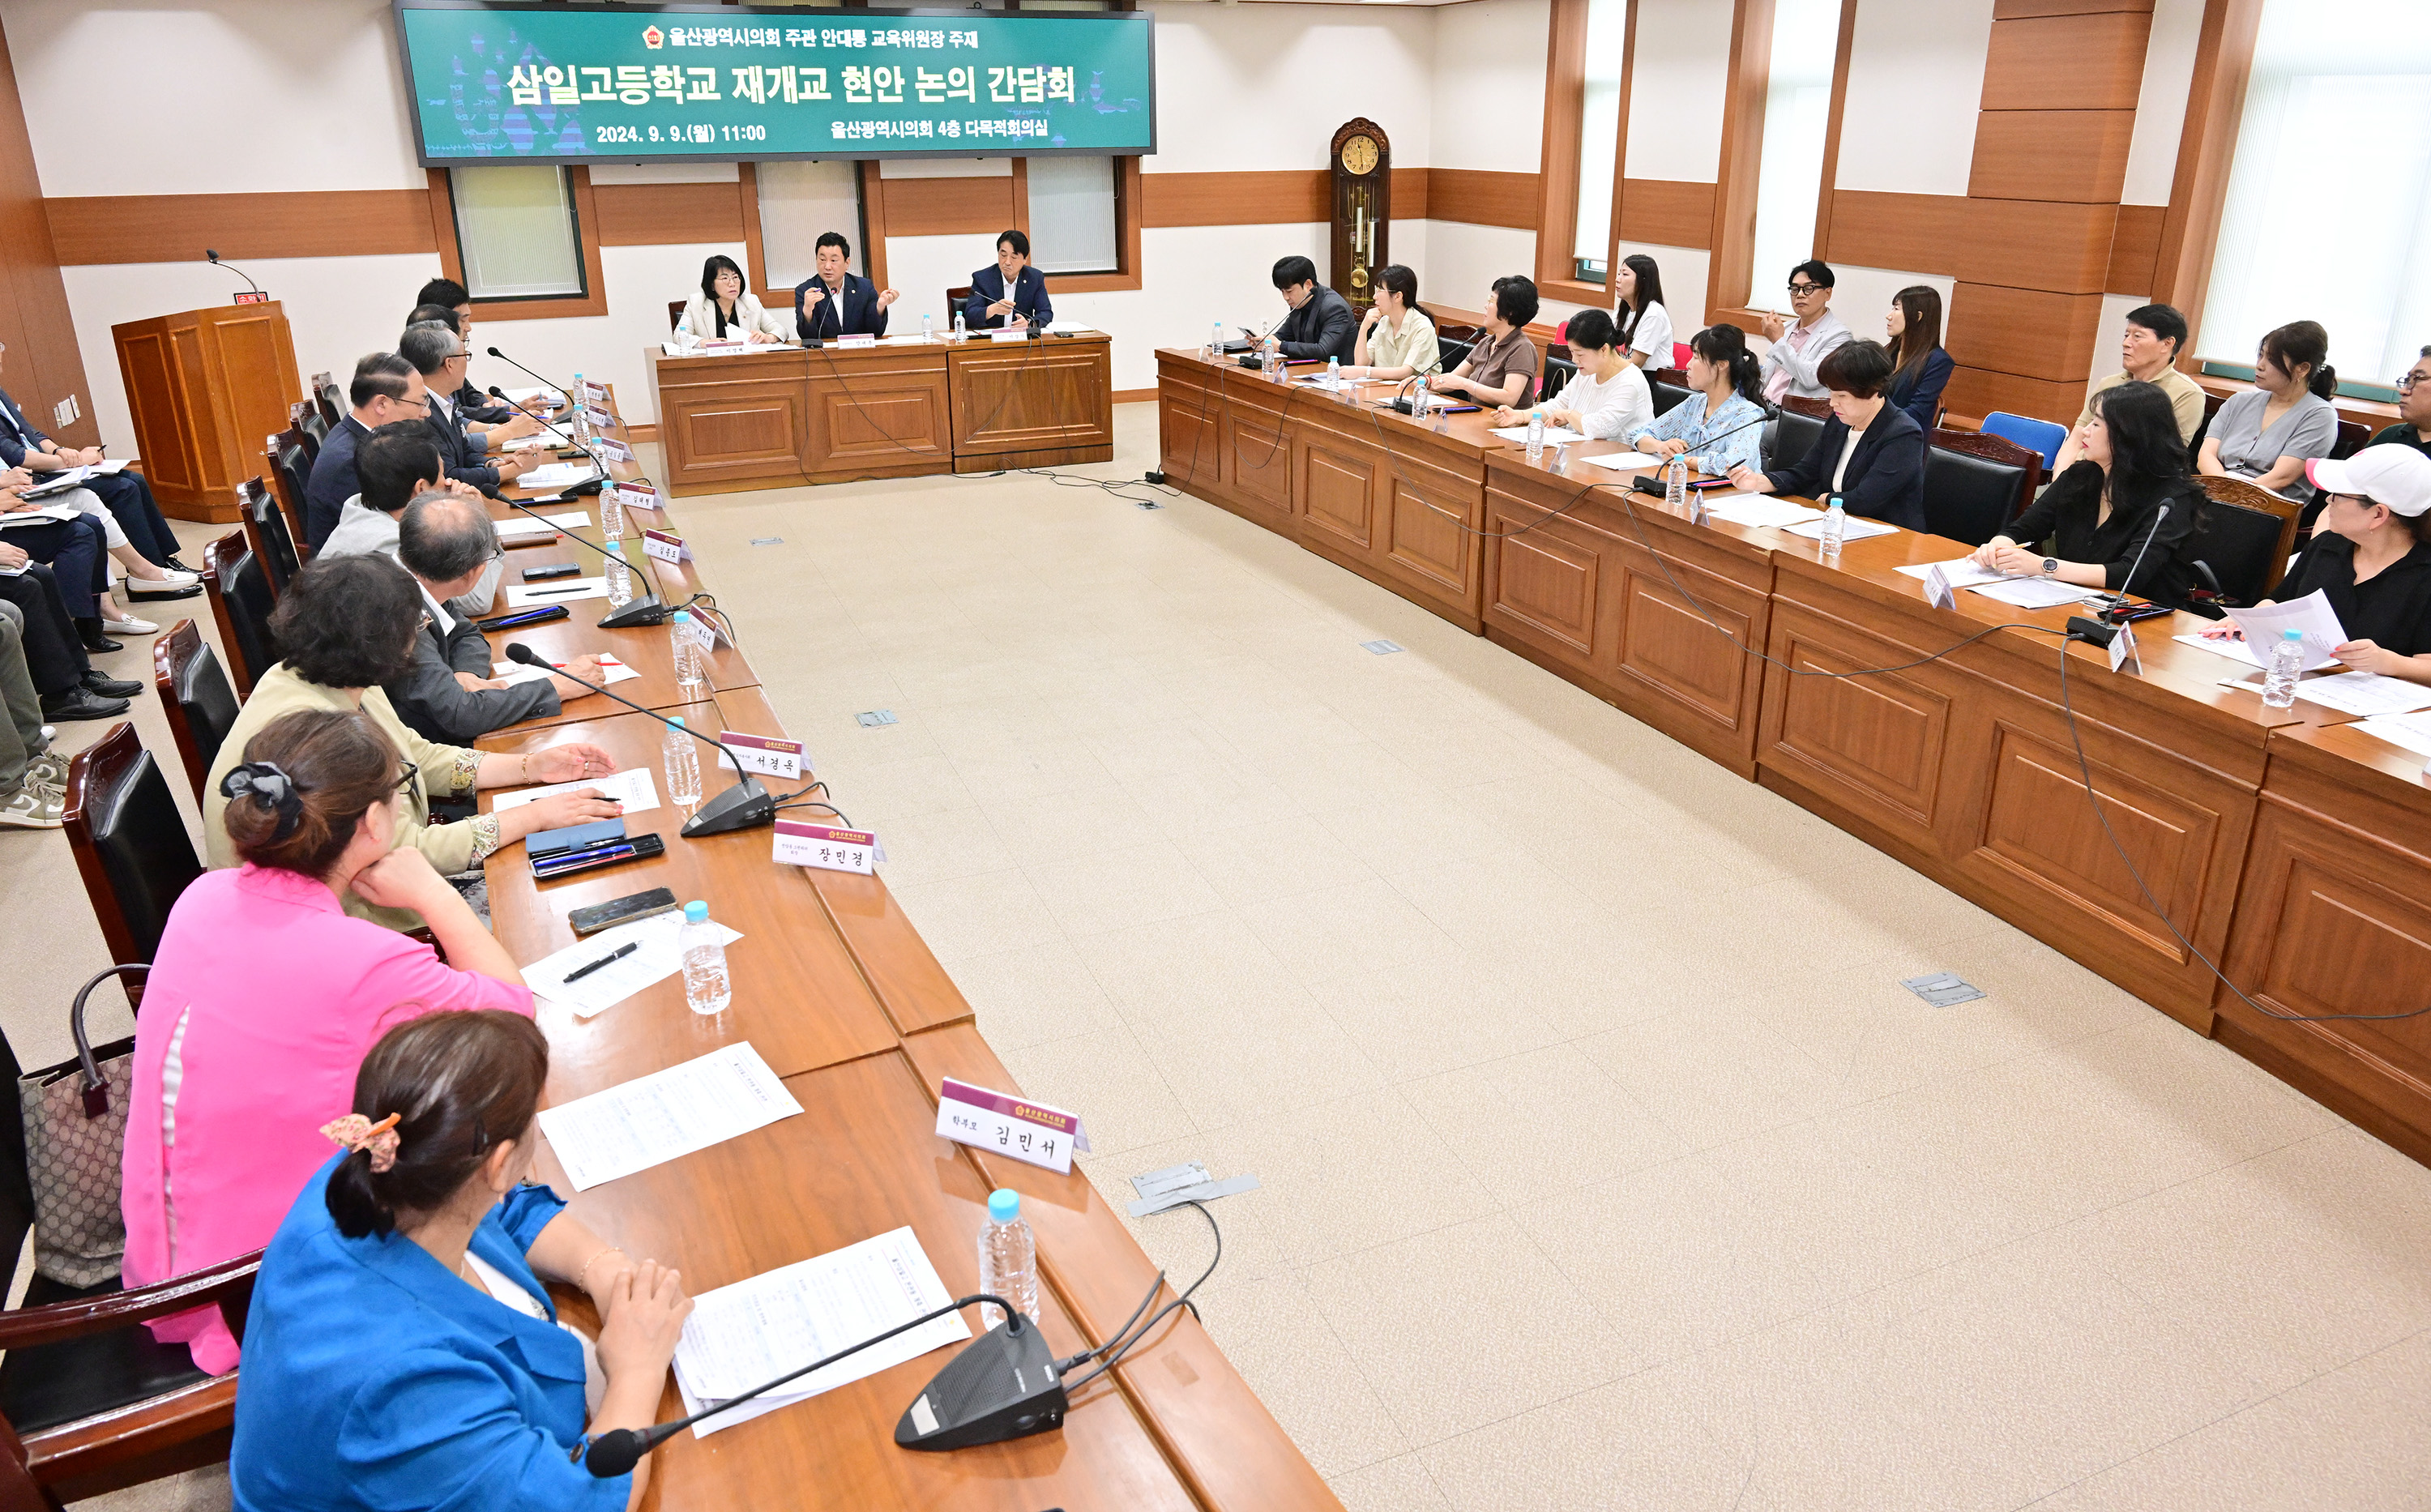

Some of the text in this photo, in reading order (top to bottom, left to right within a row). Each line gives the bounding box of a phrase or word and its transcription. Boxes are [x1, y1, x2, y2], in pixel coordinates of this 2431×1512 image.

[669, 28, 979, 49] 울산광역시의회 주관 안대룡 교육위원장 주재
[506, 65, 1075, 105] 삼일고등학교 재개교 현안 논의 간담회
[596, 126, 643, 143] 2024.
[721, 125, 766, 142] 11:00
[831, 119, 1049, 139] 울산광역시의회 4층 다목적회의실
[756, 755, 793, 772] 서경옥
[818, 848, 862, 867] 장민경
[1024, 1108, 1066, 1125] 울산광역시의회
[952, 1115, 1056, 1160] 학부모 김민서
